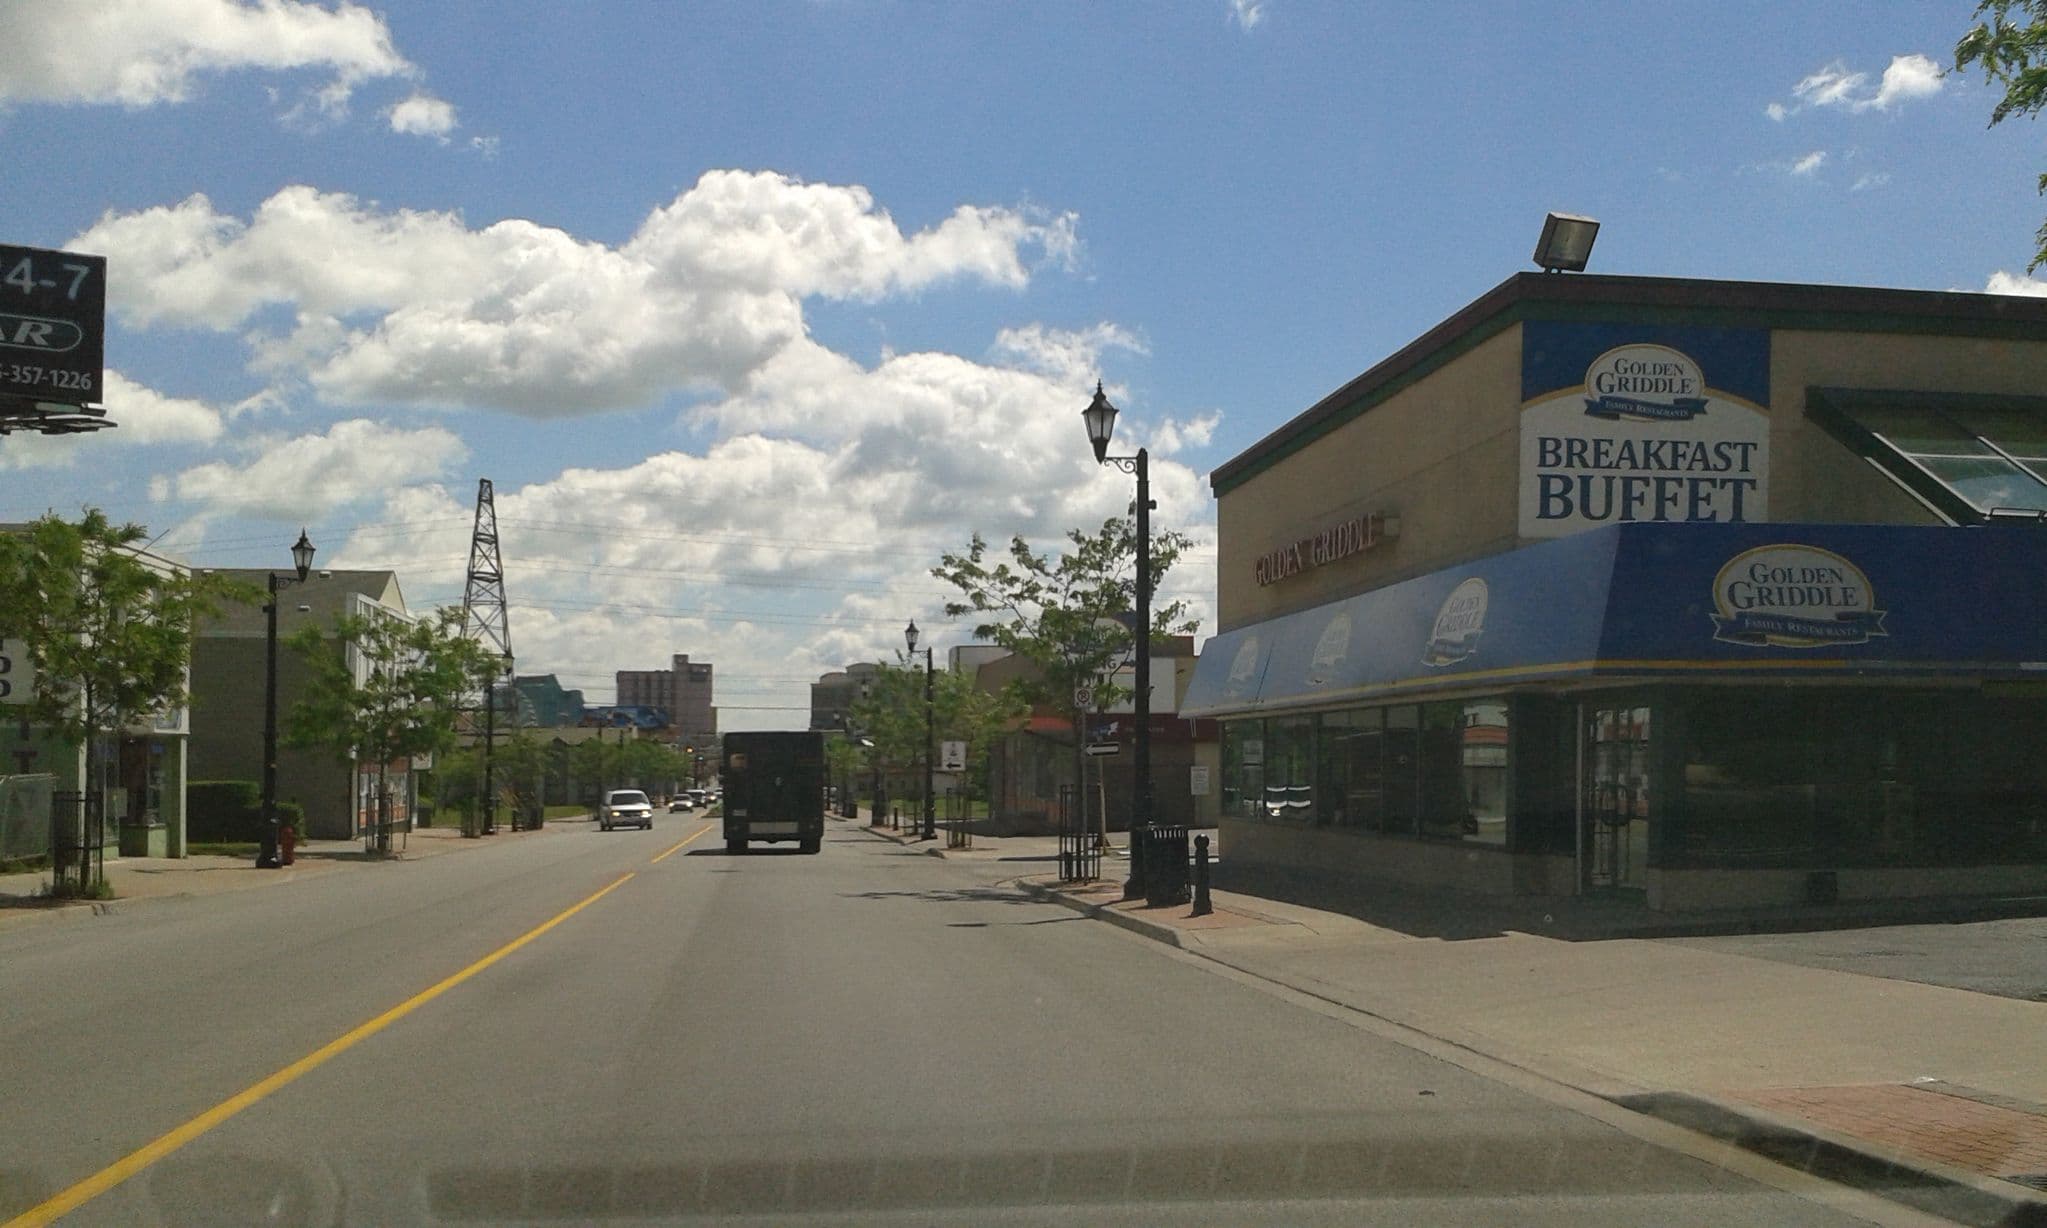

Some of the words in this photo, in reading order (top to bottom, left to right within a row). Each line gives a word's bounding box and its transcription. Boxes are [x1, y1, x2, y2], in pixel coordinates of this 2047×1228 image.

[0, 321, 53, 346] R
[1614, 357, 1684, 377] GOLDEN
[1595, 371, 1694, 394] GRIDDLE
[1537, 436, 1758, 472] BREAKFAST
[1536, 474, 1757, 522] BUFFET
[1255, 540, 1302, 585] GOLDEN
[1312, 511, 1377, 567] GRIDDLE
[1749, 562, 1844, 585] GOLDEN
[1727, 580, 1859, 610] GRIDDLE
